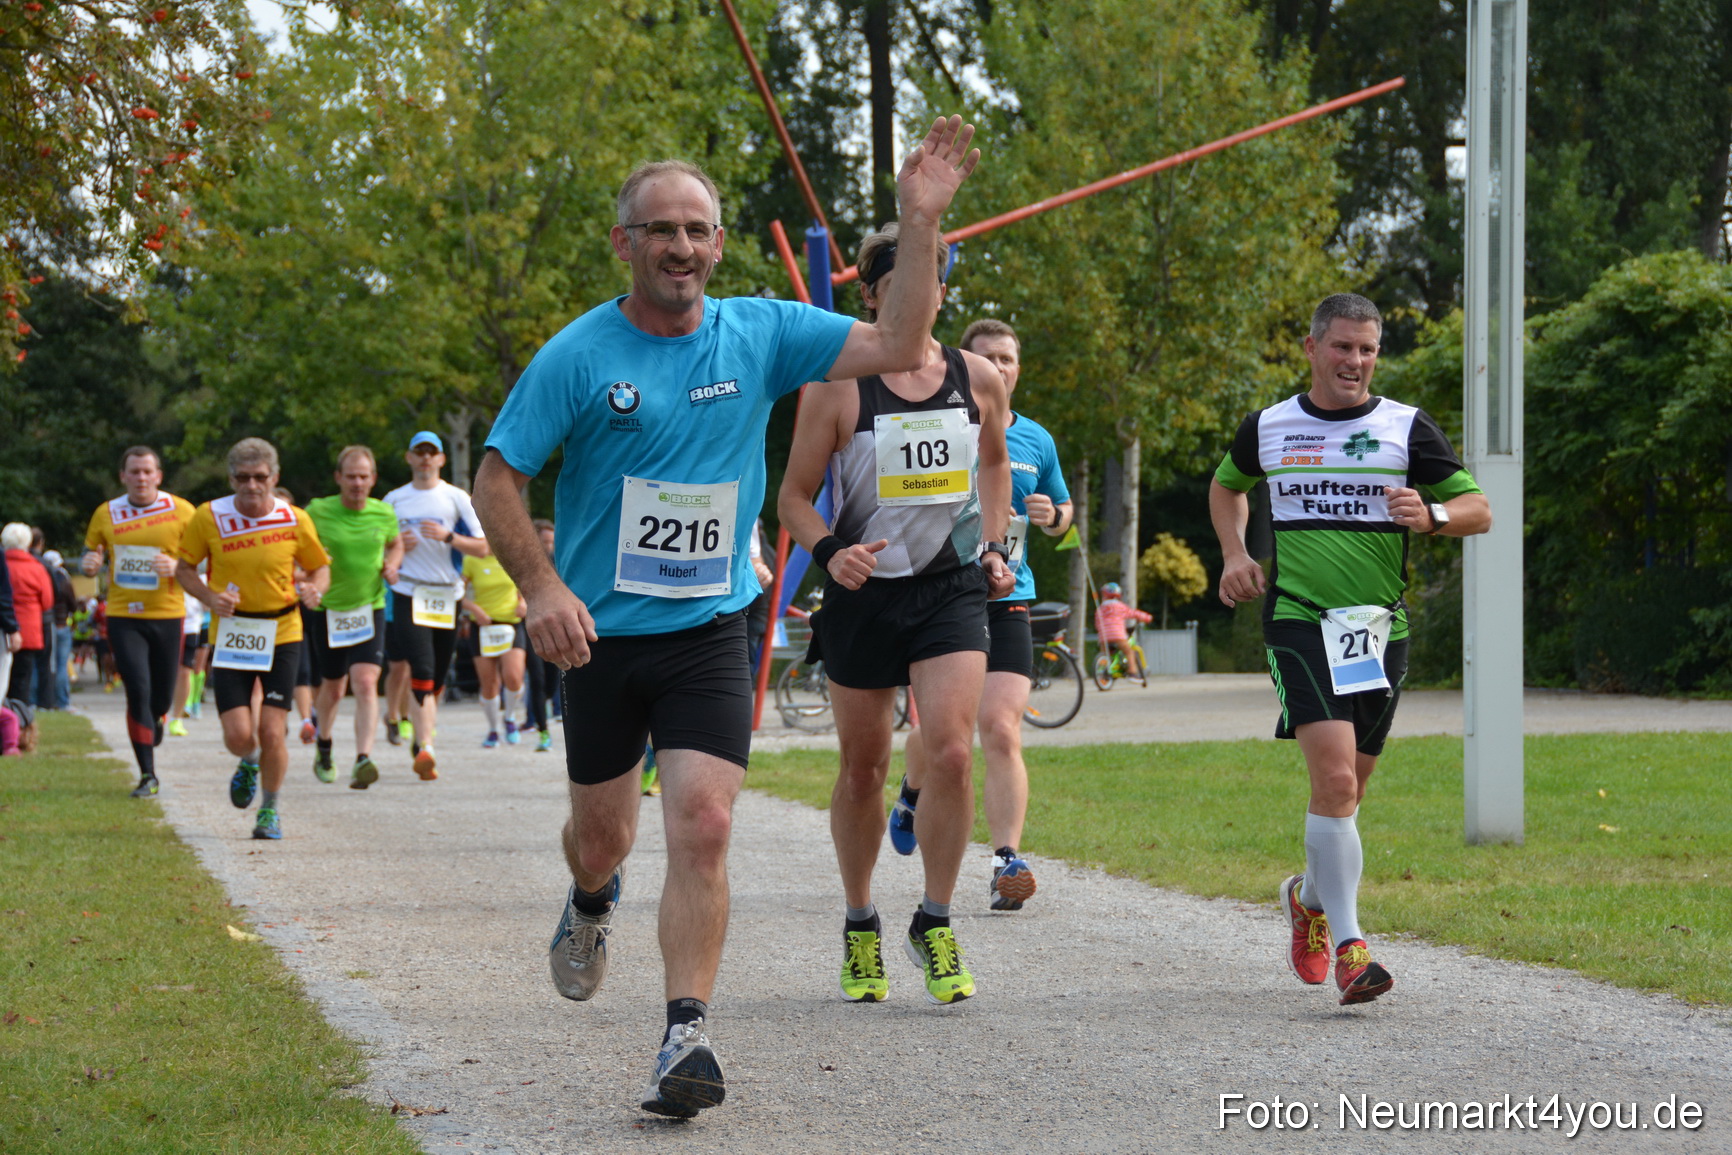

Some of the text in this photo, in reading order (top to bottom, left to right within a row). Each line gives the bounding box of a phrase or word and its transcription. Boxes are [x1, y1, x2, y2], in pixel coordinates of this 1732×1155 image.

[610, 382, 637, 394] BMW
[689, 380, 740, 402] BOCK
[609, 418, 643, 427] PARTL
[610, 425, 643, 433] Neumarkt
[911, 419, 943, 429] BOCK
[900, 439, 950, 470] 103
[1281, 456, 1324, 466] OBI
[902, 477, 949, 490] Sebastian
[1277, 480, 1391, 497] Laufteam
[670, 493, 711, 505] BOCK
[1302, 500, 1368, 515] Fürth
[637, 515, 720, 553] 2216
[221, 537, 257, 553] MAX
[120, 558, 152, 573] 2625
[659, 563, 698, 578] Hubert
[423, 599, 445, 612] 149
[225, 632, 266, 651] 2630
